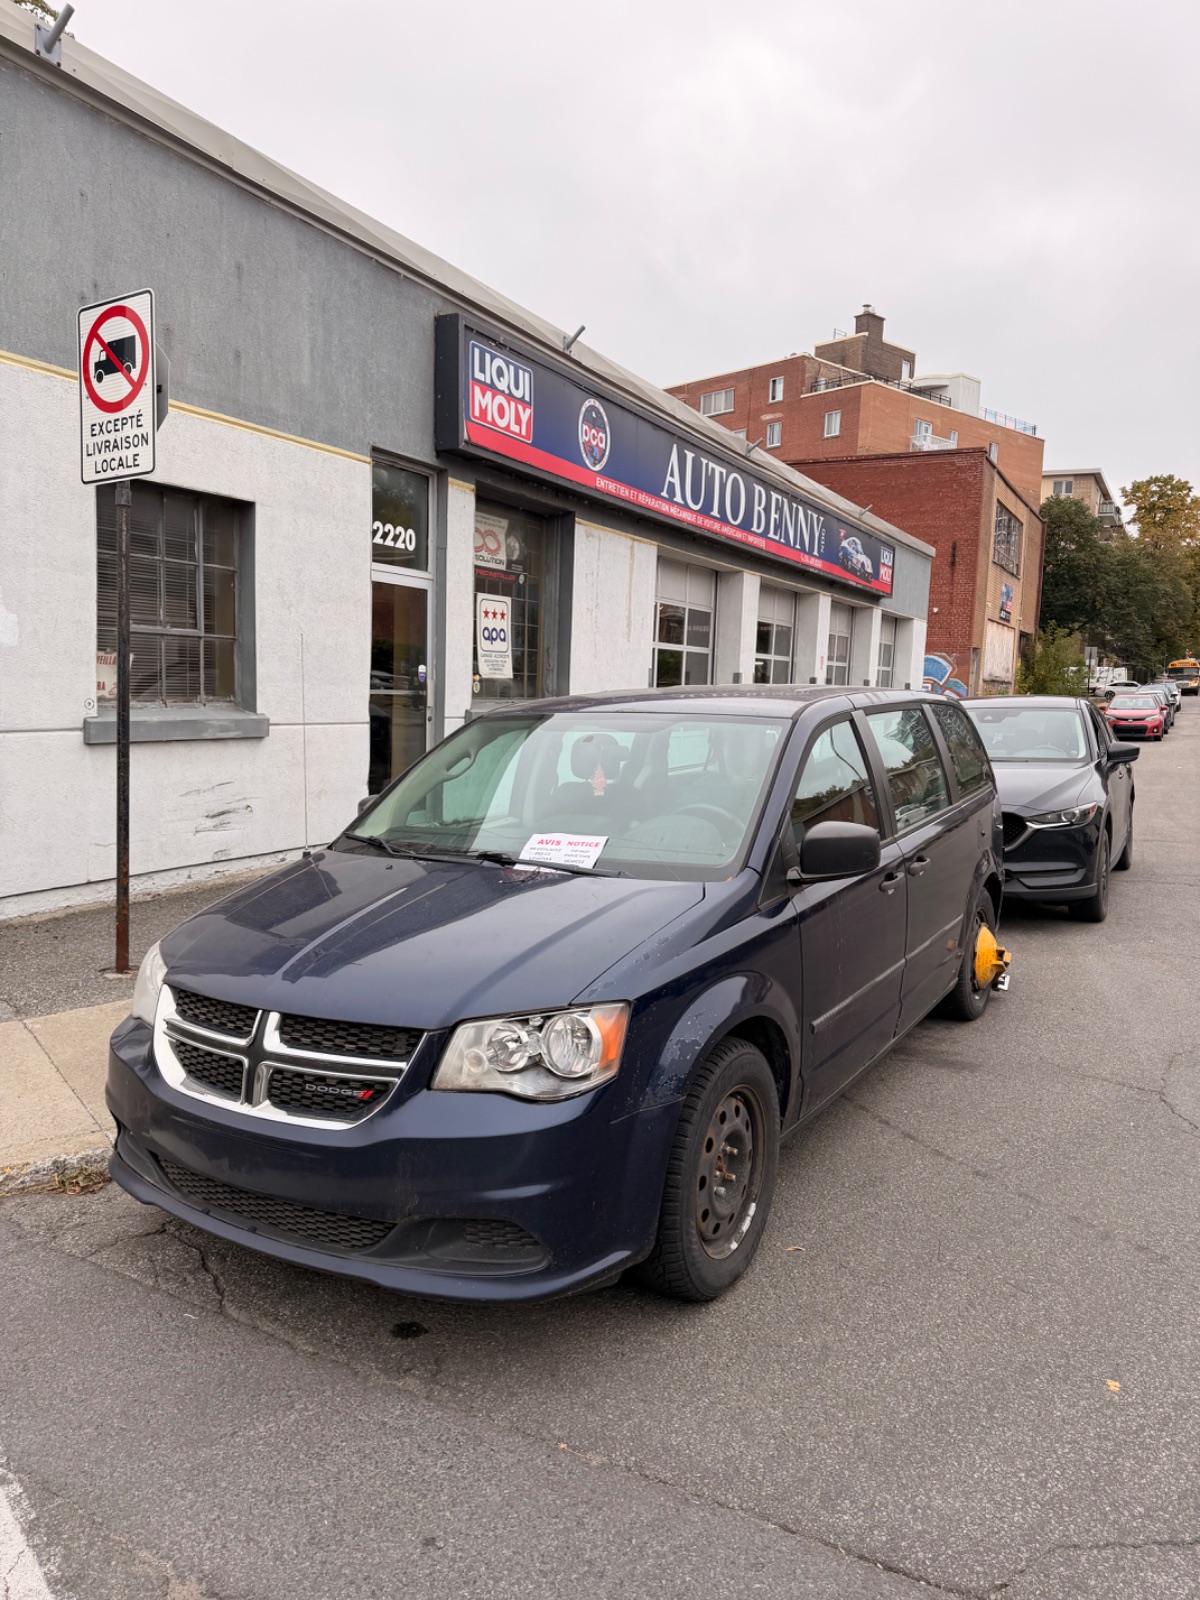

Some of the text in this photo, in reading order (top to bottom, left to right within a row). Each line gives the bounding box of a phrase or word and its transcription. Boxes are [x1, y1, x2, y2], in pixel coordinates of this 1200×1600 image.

[474, 347, 531, 402] LIQUI
[90, 409, 144, 437] EXCEPTÉ
[473, 385, 532, 436] MOLY
[86, 432, 149, 457] LIVRAISON
[94, 453, 140, 474] LOCALE
[595, 476, 629, 498] ENTRETIEN
[630, 489, 637, 501] ET
[638, 492, 670, 513] RÉPARATION
[660, 443, 825, 557] AUTO BENNY
[372, 520, 416, 551] 2220
[482, 626, 507, 645] apa
[305, 1083, 363, 1097] DODGE
